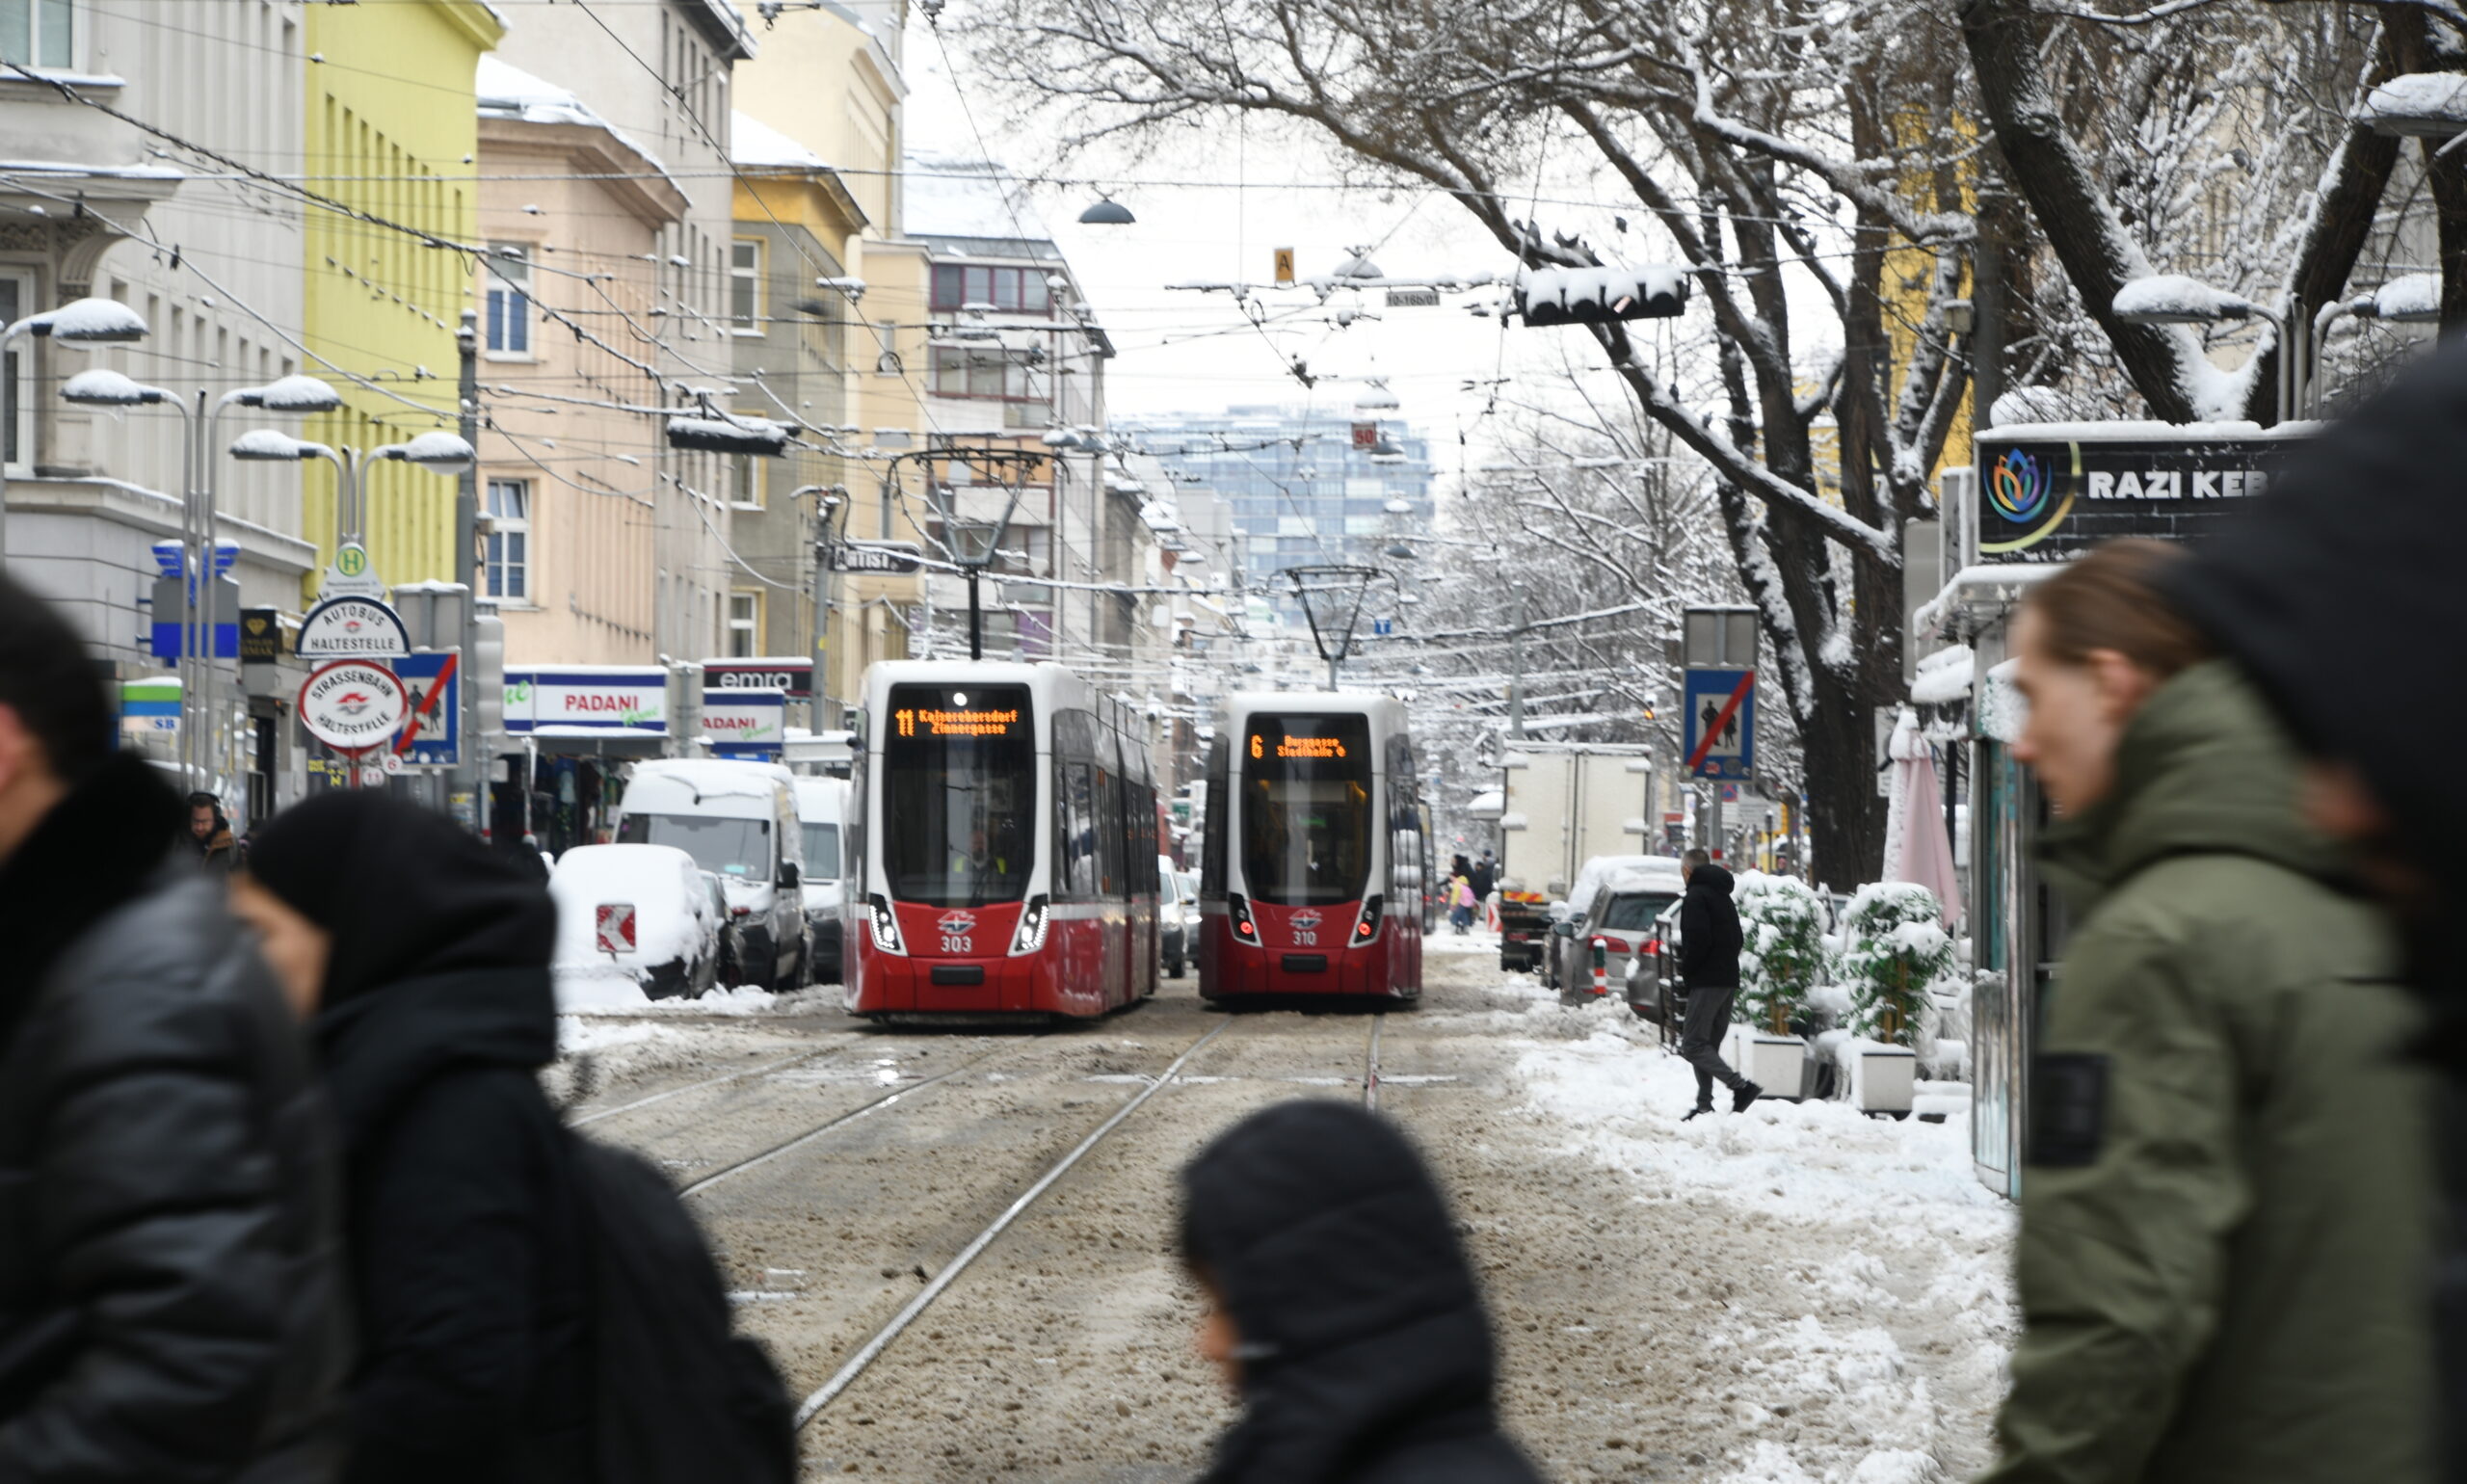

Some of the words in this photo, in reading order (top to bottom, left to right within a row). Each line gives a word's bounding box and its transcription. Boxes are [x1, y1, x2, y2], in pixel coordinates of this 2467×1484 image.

[1278, 254, 1291, 272] A
[1355, 429, 1374, 444] 50
[2088, 470, 2182, 499] RAZI
[2192, 470, 2270, 498] KEB
[344, 553, 358, 570] H
[323, 604, 385, 626] AUTOBUS
[310, 638, 395, 649] HALTESTELLE
[311, 670, 394, 702] STRASSENBAHN
[719, 672, 792, 690] emra
[565, 694, 639, 711] PADANI
[154, 718, 175, 729] SB
[316, 710, 393, 734] HALTESTELLE
[703, 717, 756, 729] ADANI
[895, 708, 915, 736] 11
[918, 709, 1018, 723] Kaiserebersdorf
[931, 723, 1006, 737] Zinnergasse
[1250, 734, 1263, 759] 6
[941, 935, 972, 953] 303
[1292, 930, 1317, 946] 310
